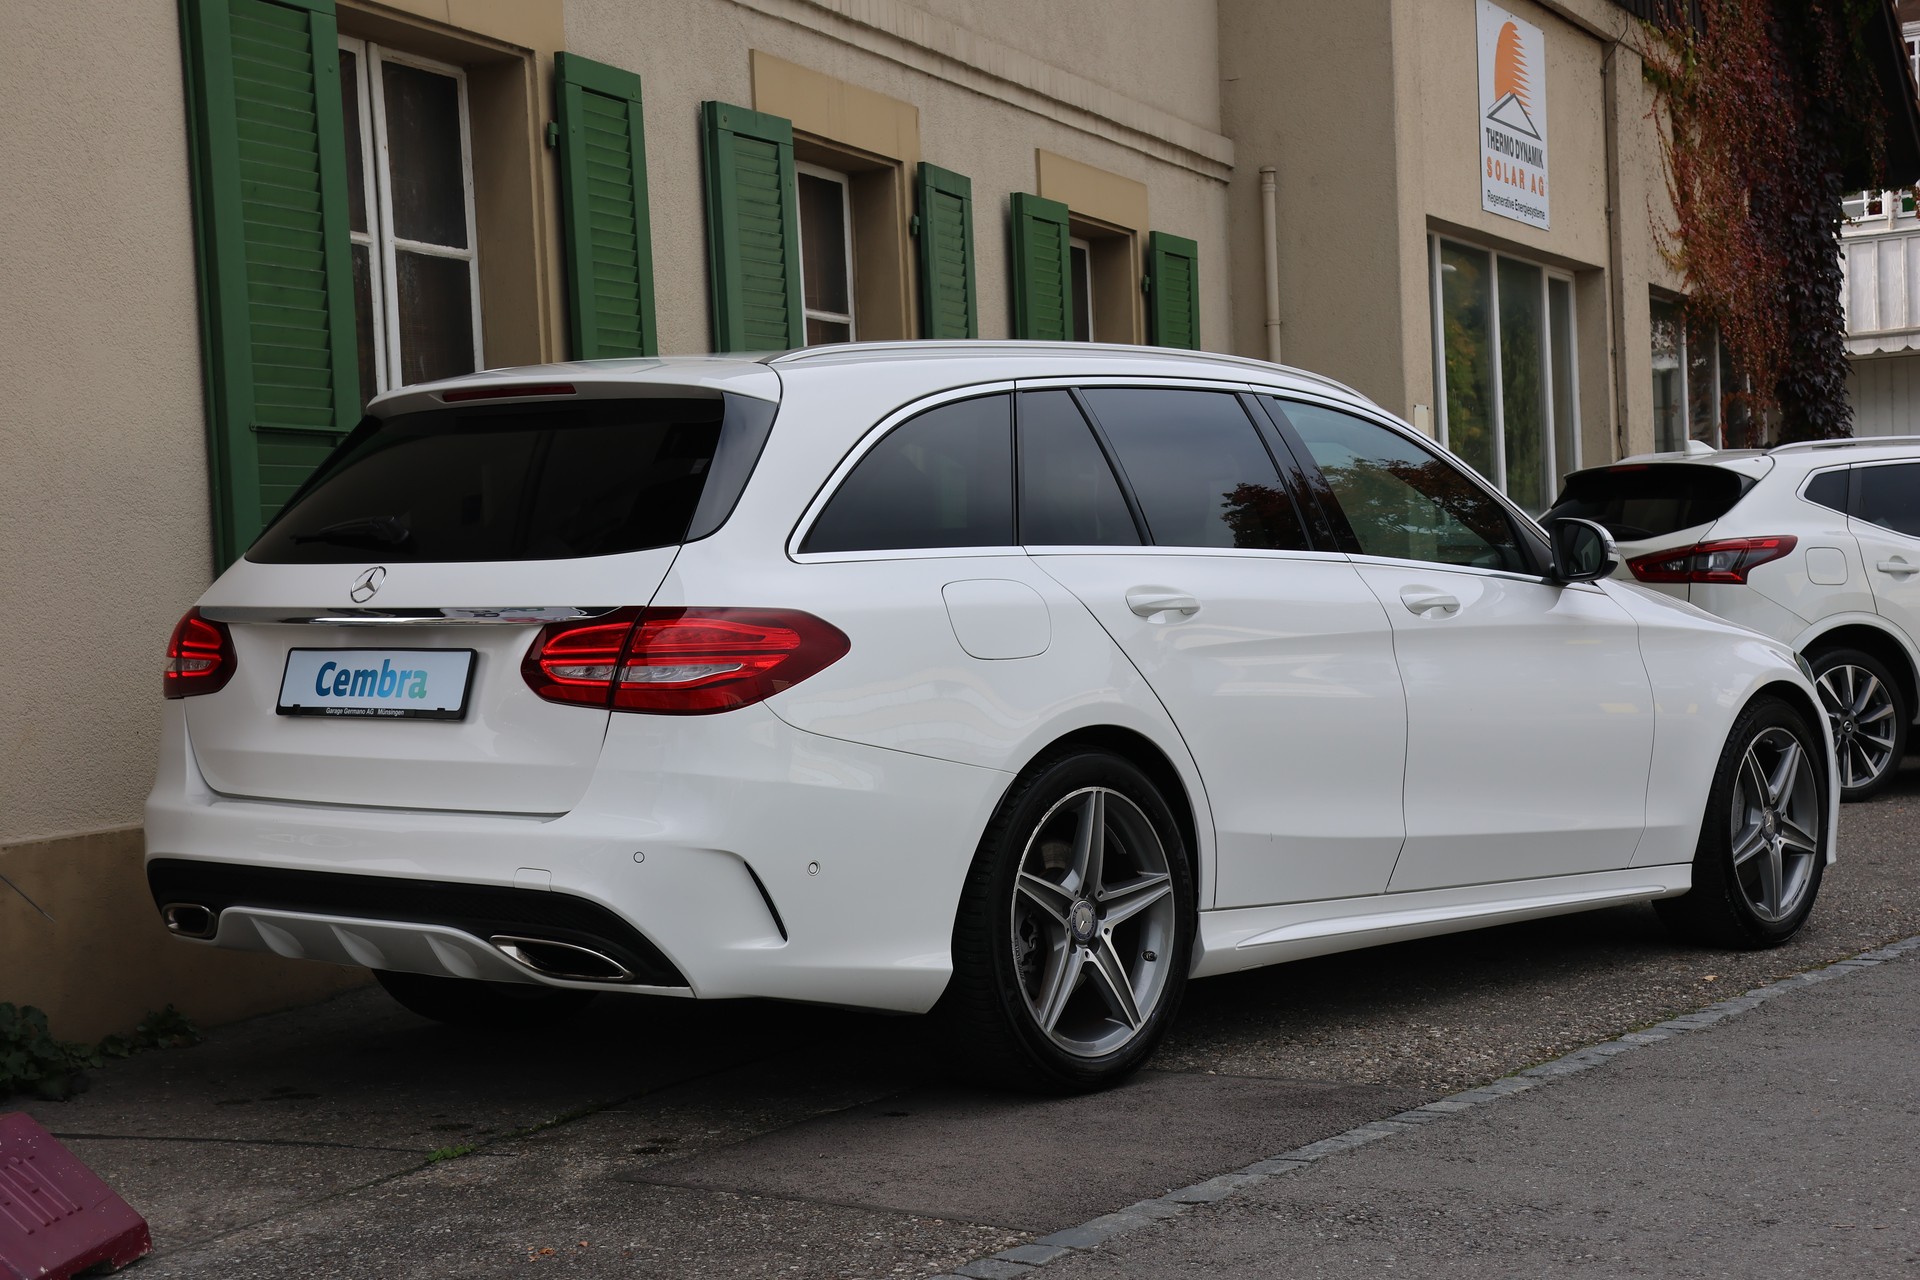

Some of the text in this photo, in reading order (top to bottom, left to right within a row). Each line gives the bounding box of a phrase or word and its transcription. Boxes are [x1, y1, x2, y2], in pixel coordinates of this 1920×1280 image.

[1486, 127, 1544, 170] THERMO DYNAMIK
[1486, 155, 1545, 197] SOLAR AG
[1487, 189, 1546, 220] Regenerative Energiesysteme
[315, 659, 428, 699] Cembra
[326, 707, 343, 716] Garage
[344, 707, 366, 715] Germano
[377, 708, 405, 717] Münsingen
